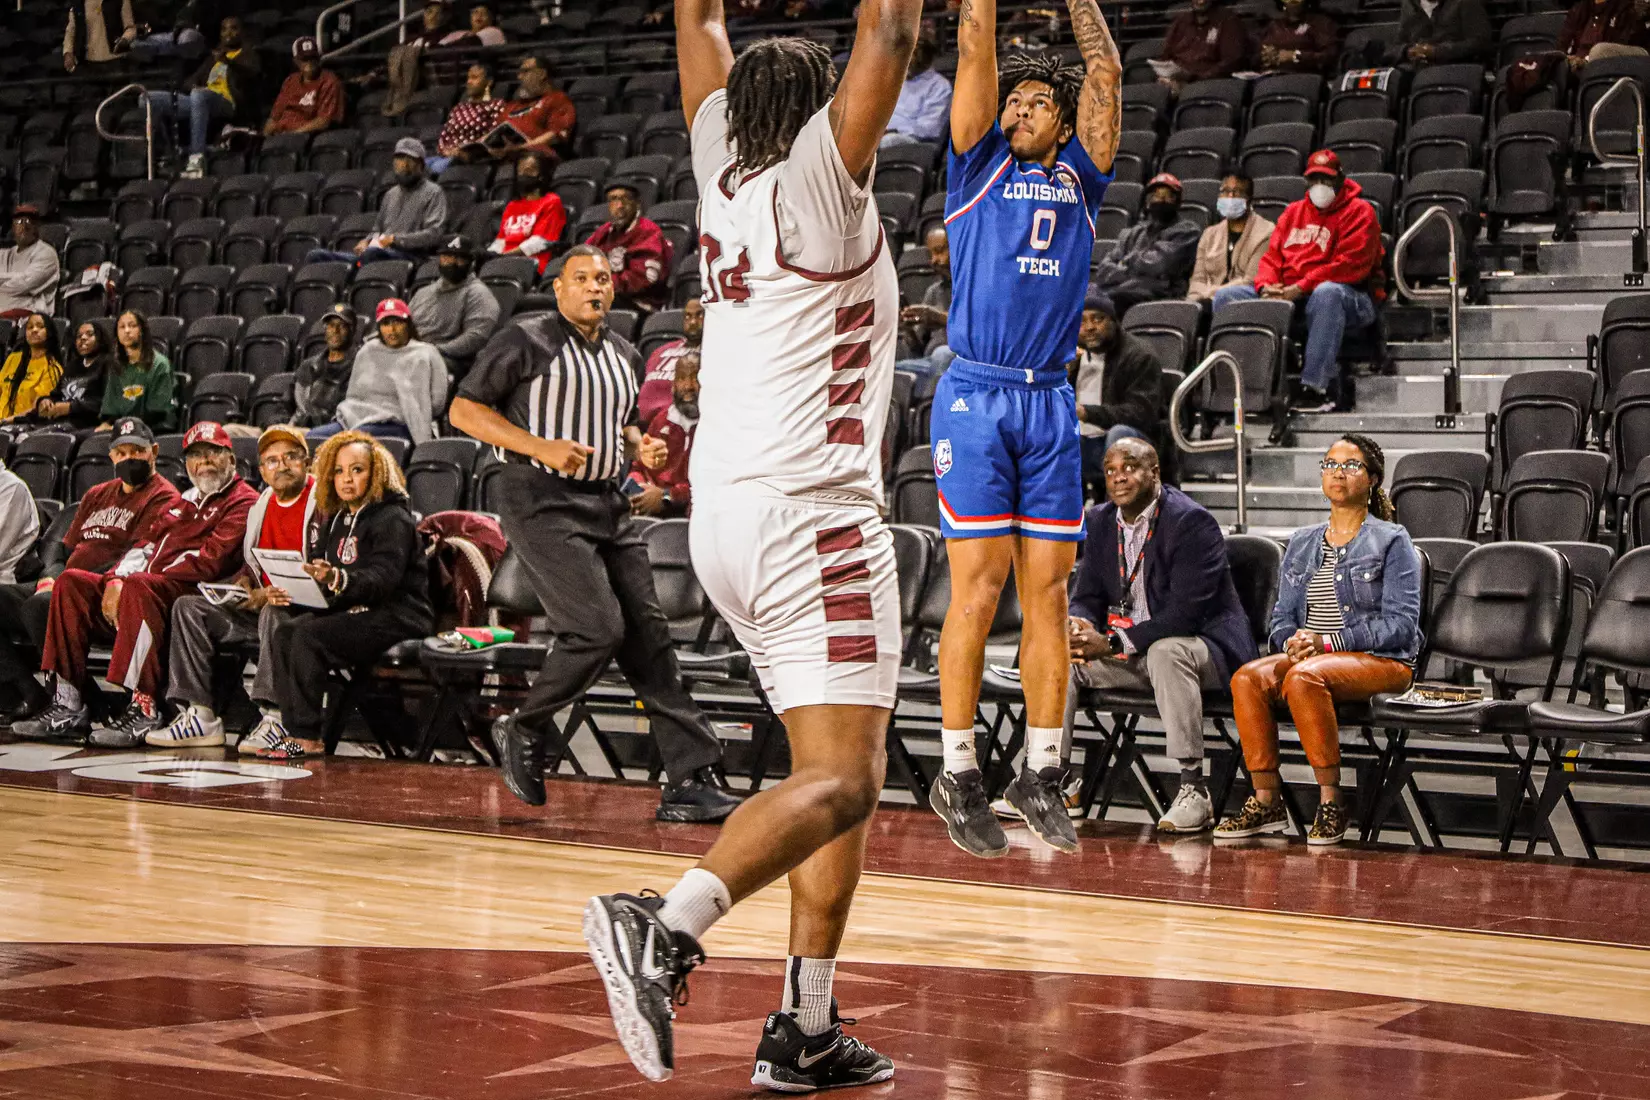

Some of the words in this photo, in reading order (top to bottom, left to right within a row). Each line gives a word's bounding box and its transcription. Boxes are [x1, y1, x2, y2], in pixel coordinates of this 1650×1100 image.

[1002, 182, 1078, 204] LOUISIANA
[1029, 208, 1057, 250] 0
[1016, 256, 1060, 276] TECH
